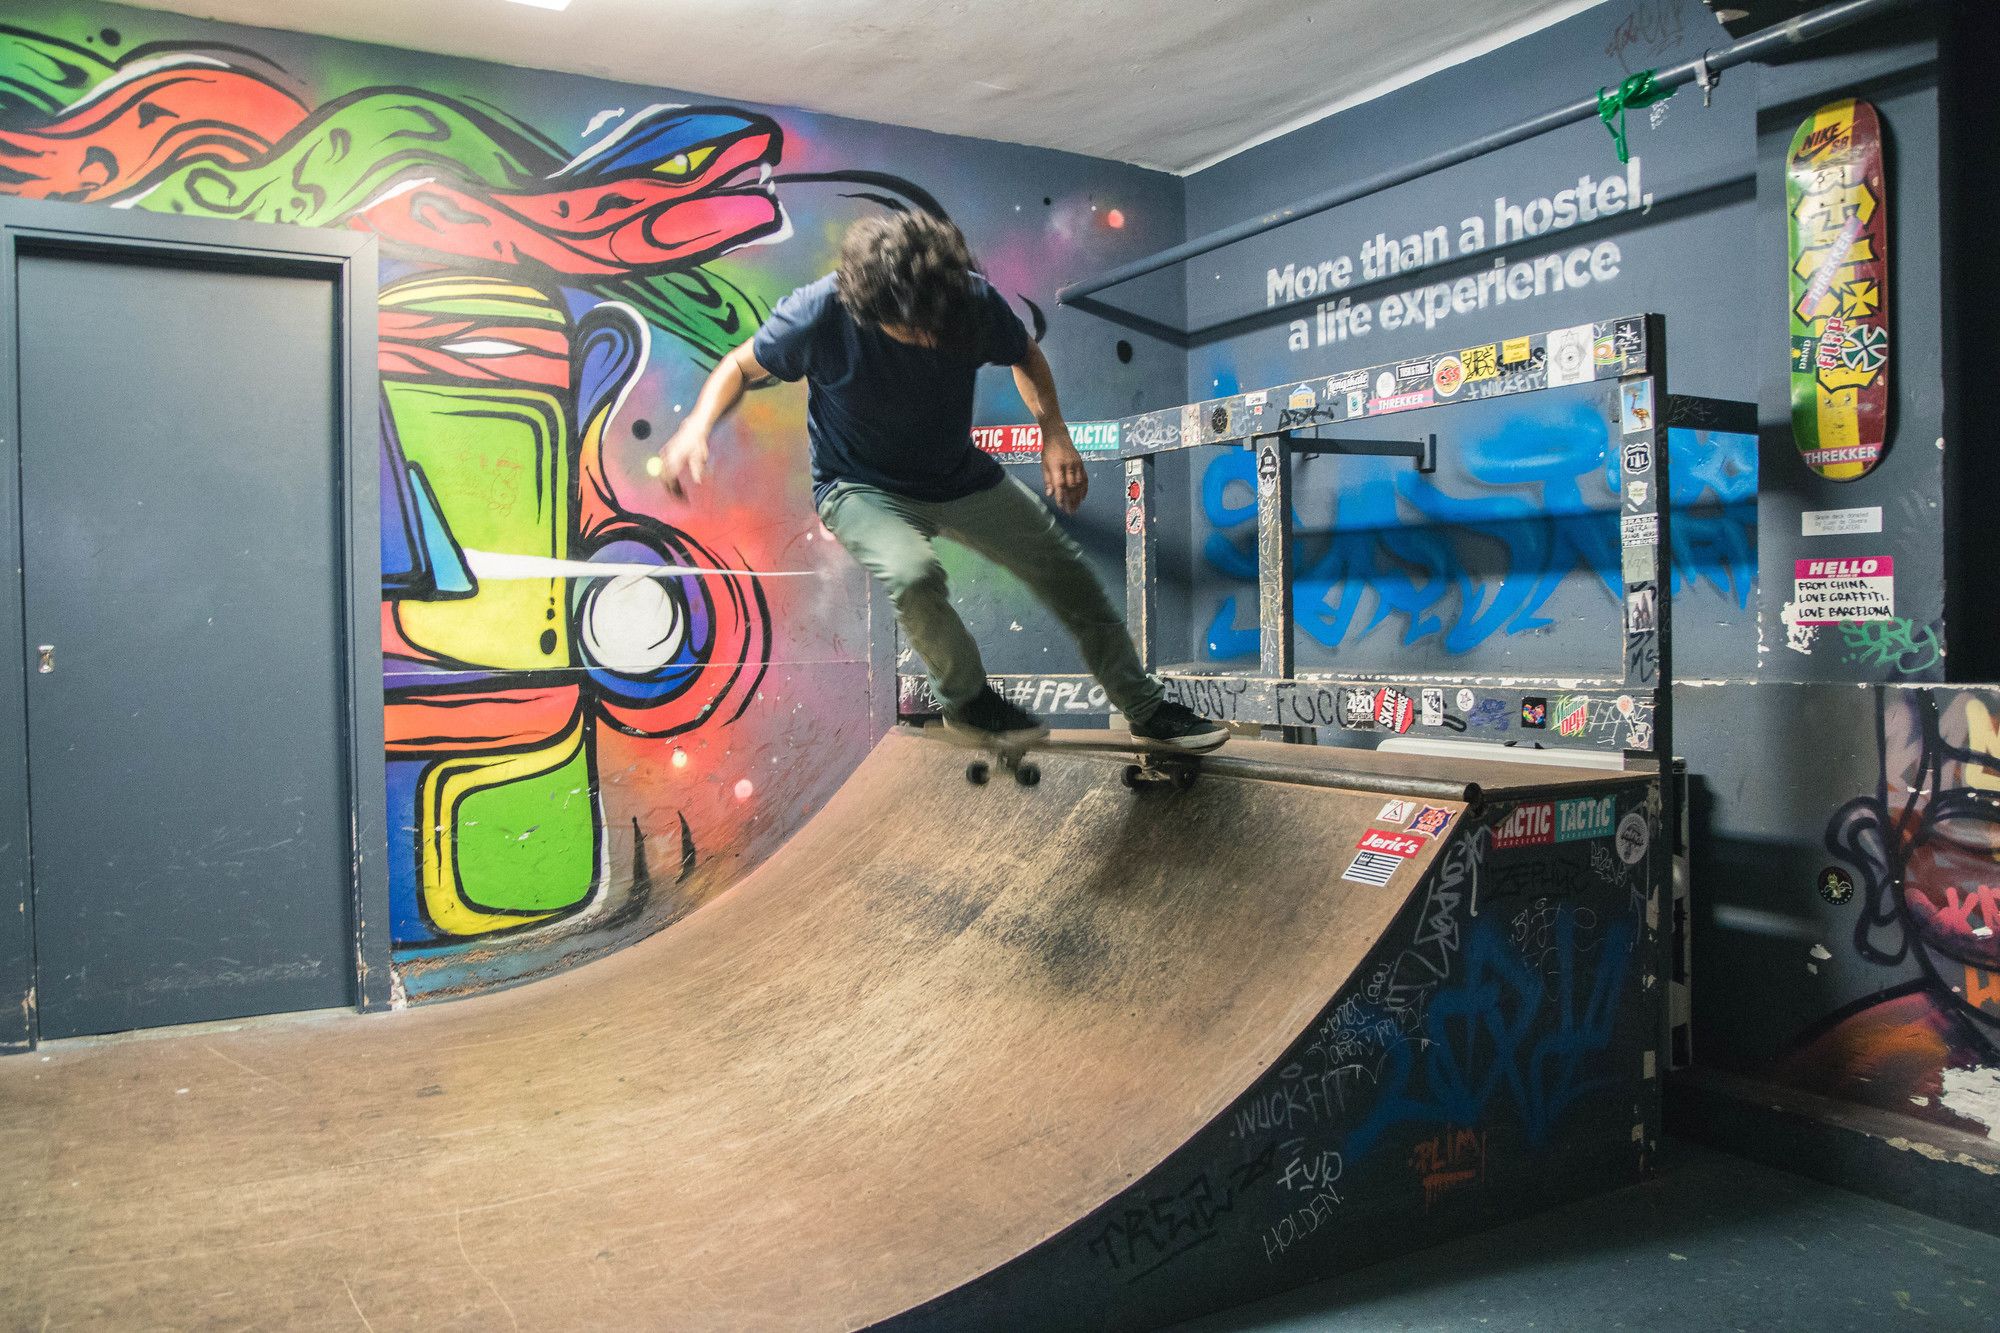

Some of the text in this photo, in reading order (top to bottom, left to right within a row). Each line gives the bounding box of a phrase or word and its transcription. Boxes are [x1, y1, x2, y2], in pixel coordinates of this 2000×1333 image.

[1800, 121, 1842, 152] NIKE
[1267, 156, 1654, 307] More than a hostel,
[1809, 230, 1854, 302] THREKKER
[1287, 241, 1622, 353] a life experience
[1798, 339, 1812, 371] DMND
[1377, 393, 1425, 411] THREKKER
[1010, 427, 1043, 447] TACT
[1069, 424, 1118, 446] TACTIC
[1804, 446, 1877, 464] THREKKER
[1808, 559, 1878, 576] HELLO
[1798, 581, 1828, 592] FROM
[1798, 592, 1827, 604] LOVE
[1798, 605, 1893, 619] LOVE BARCELONA
[1005, 679, 1118, 713] #FPLO
[1347, 695, 1375, 713] 420
[1378, 687, 1397, 728] SKATE
[1560, 797, 1612, 833] TACTIC
[1361, 833, 1419, 855] Jeric's
